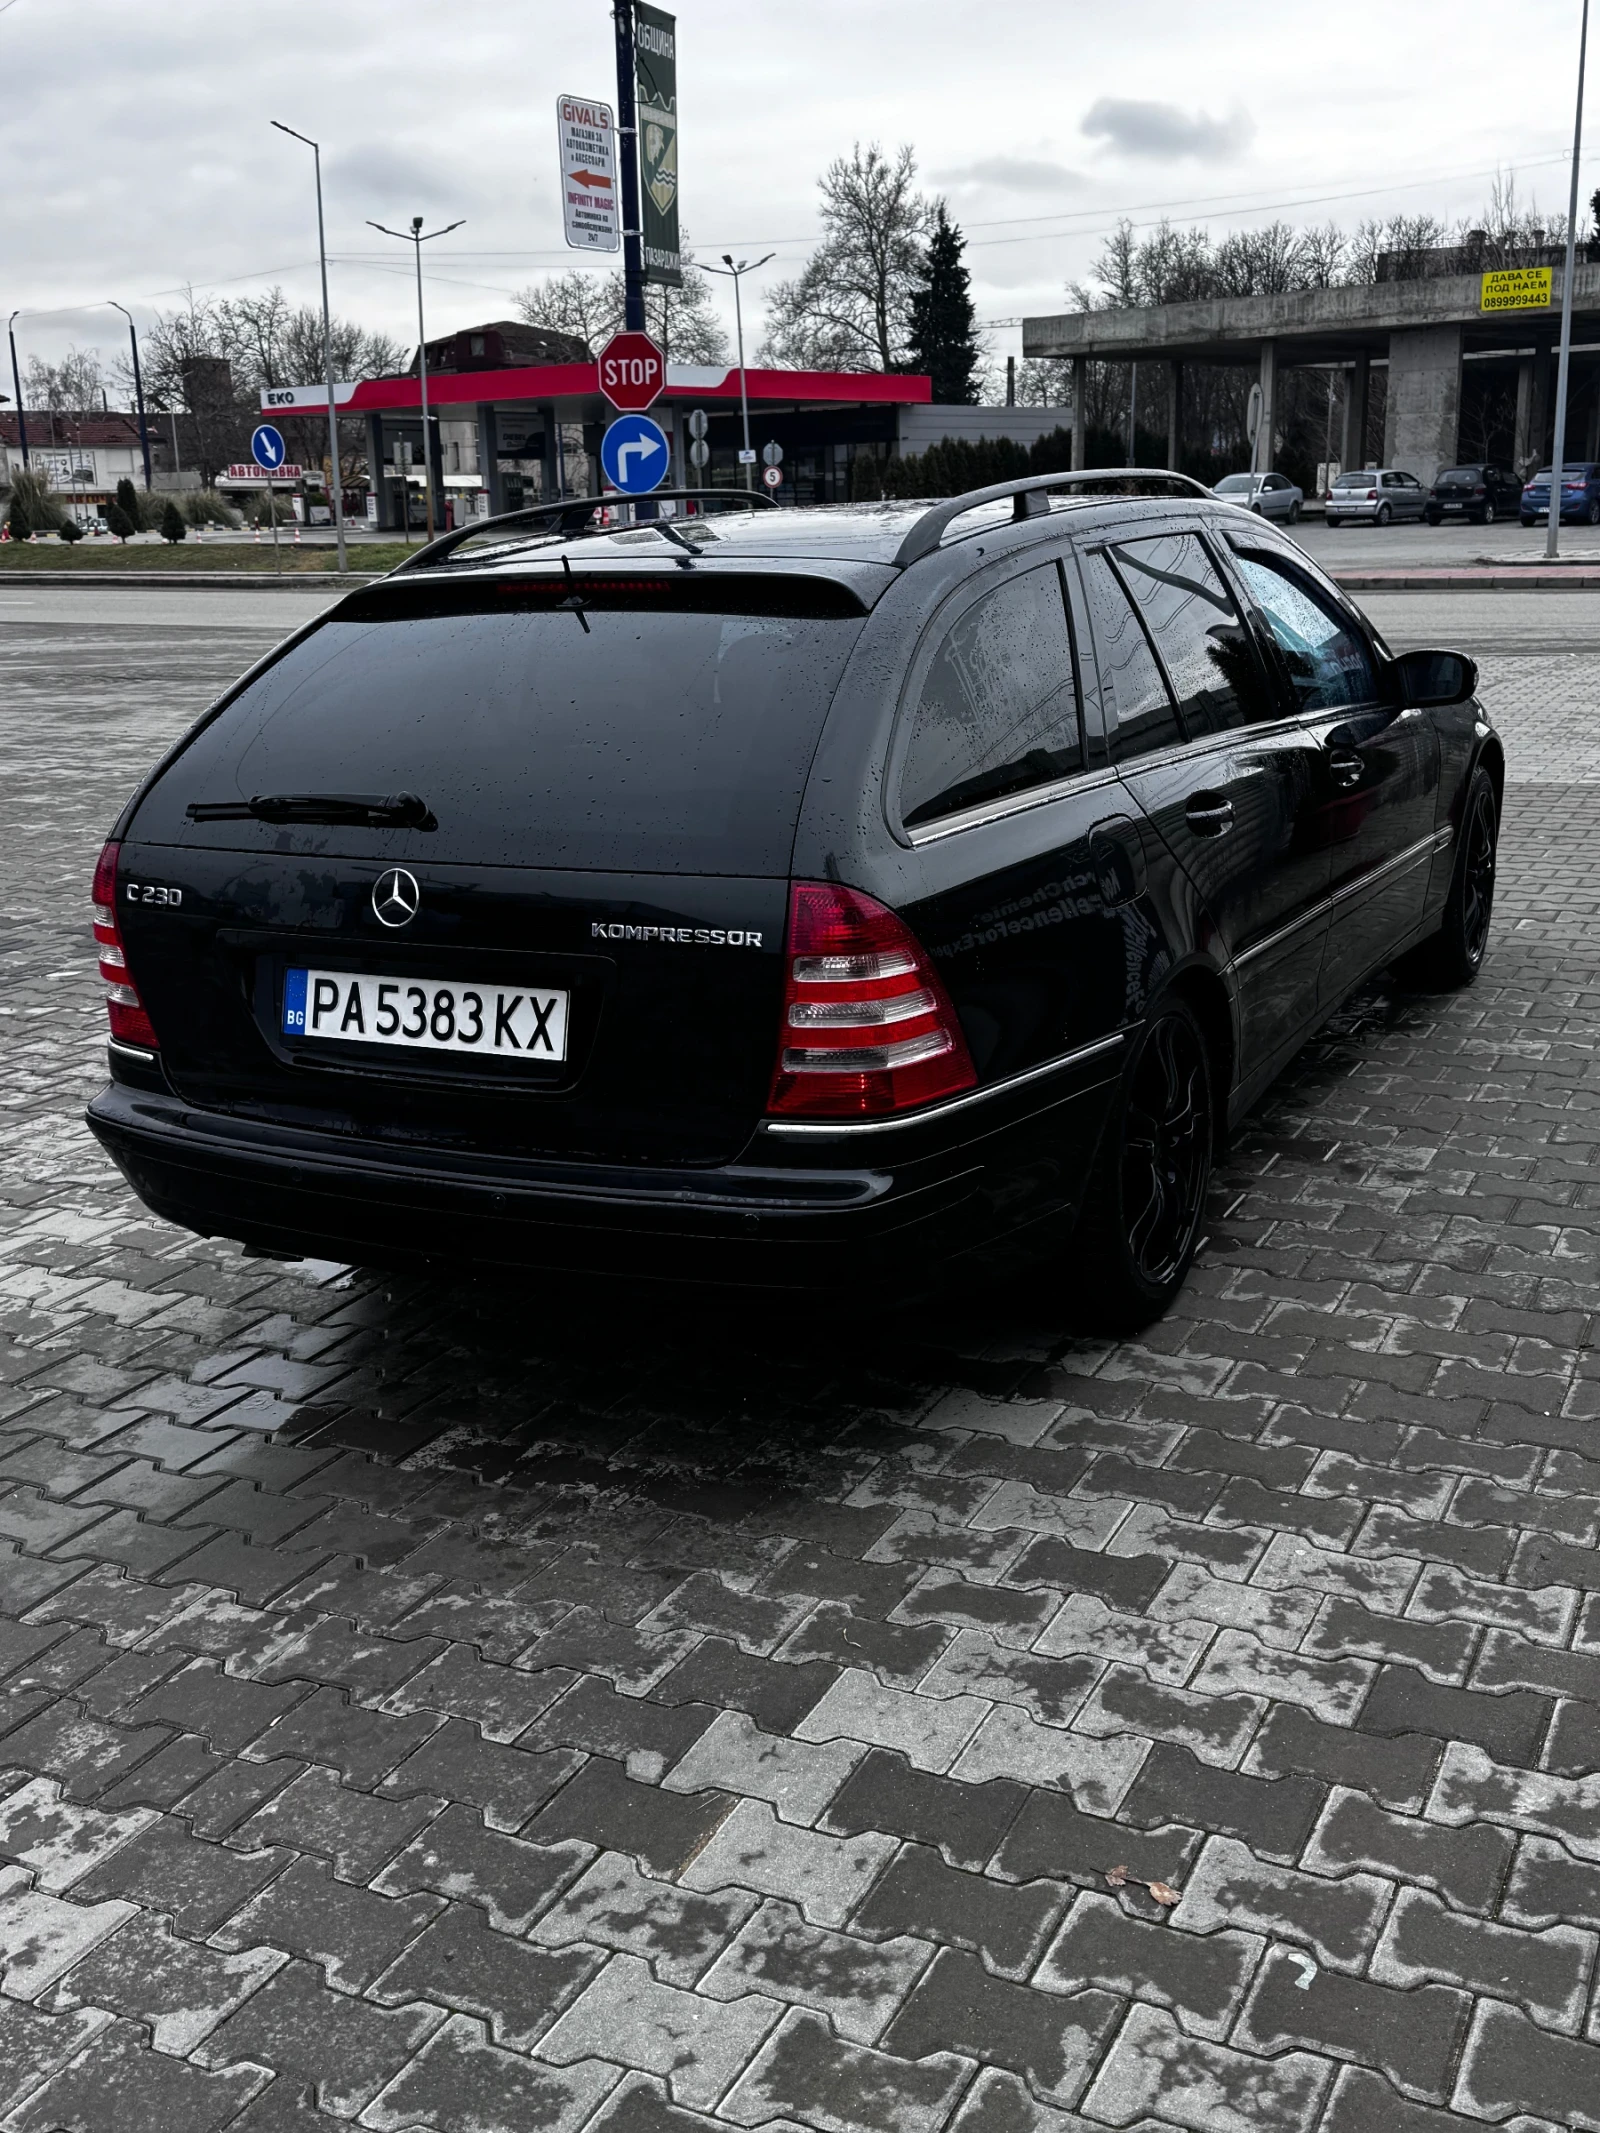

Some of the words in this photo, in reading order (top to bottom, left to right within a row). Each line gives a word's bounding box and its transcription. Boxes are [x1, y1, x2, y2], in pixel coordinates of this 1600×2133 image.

[637, 21, 675, 60] ОБЩИНА
[563, 103, 608, 130] GIVALS
[571, 127, 595, 141] МАГАЗИН
[596, 132, 603, 143] ЗА
[566, 138, 609, 156] АВТОКОЗМЕТИКА
[575, 153, 605, 168] АКСЕСОАРИ
[567, 191, 593, 208] INFINITY
[594, 196, 614, 211] MAGIC
[1491, 272, 1523, 284] ДАВА
[1527, 270, 1543, 279] СЕ
[1486, 283, 1510, 293] ПОД
[1513, 280, 1547, 291] НАЕМ
[1484, 293, 1548, 308] 0899999443
[605, 358, 658, 386] STOP
[267, 391, 294, 405] EKO
[769, 471, 776, 482] 5
[126, 883, 139, 901] C
[142, 886, 182, 907] 230
[591, 922, 763, 947] KOMPRESSOR
[287, 1009, 304, 1026] BG
